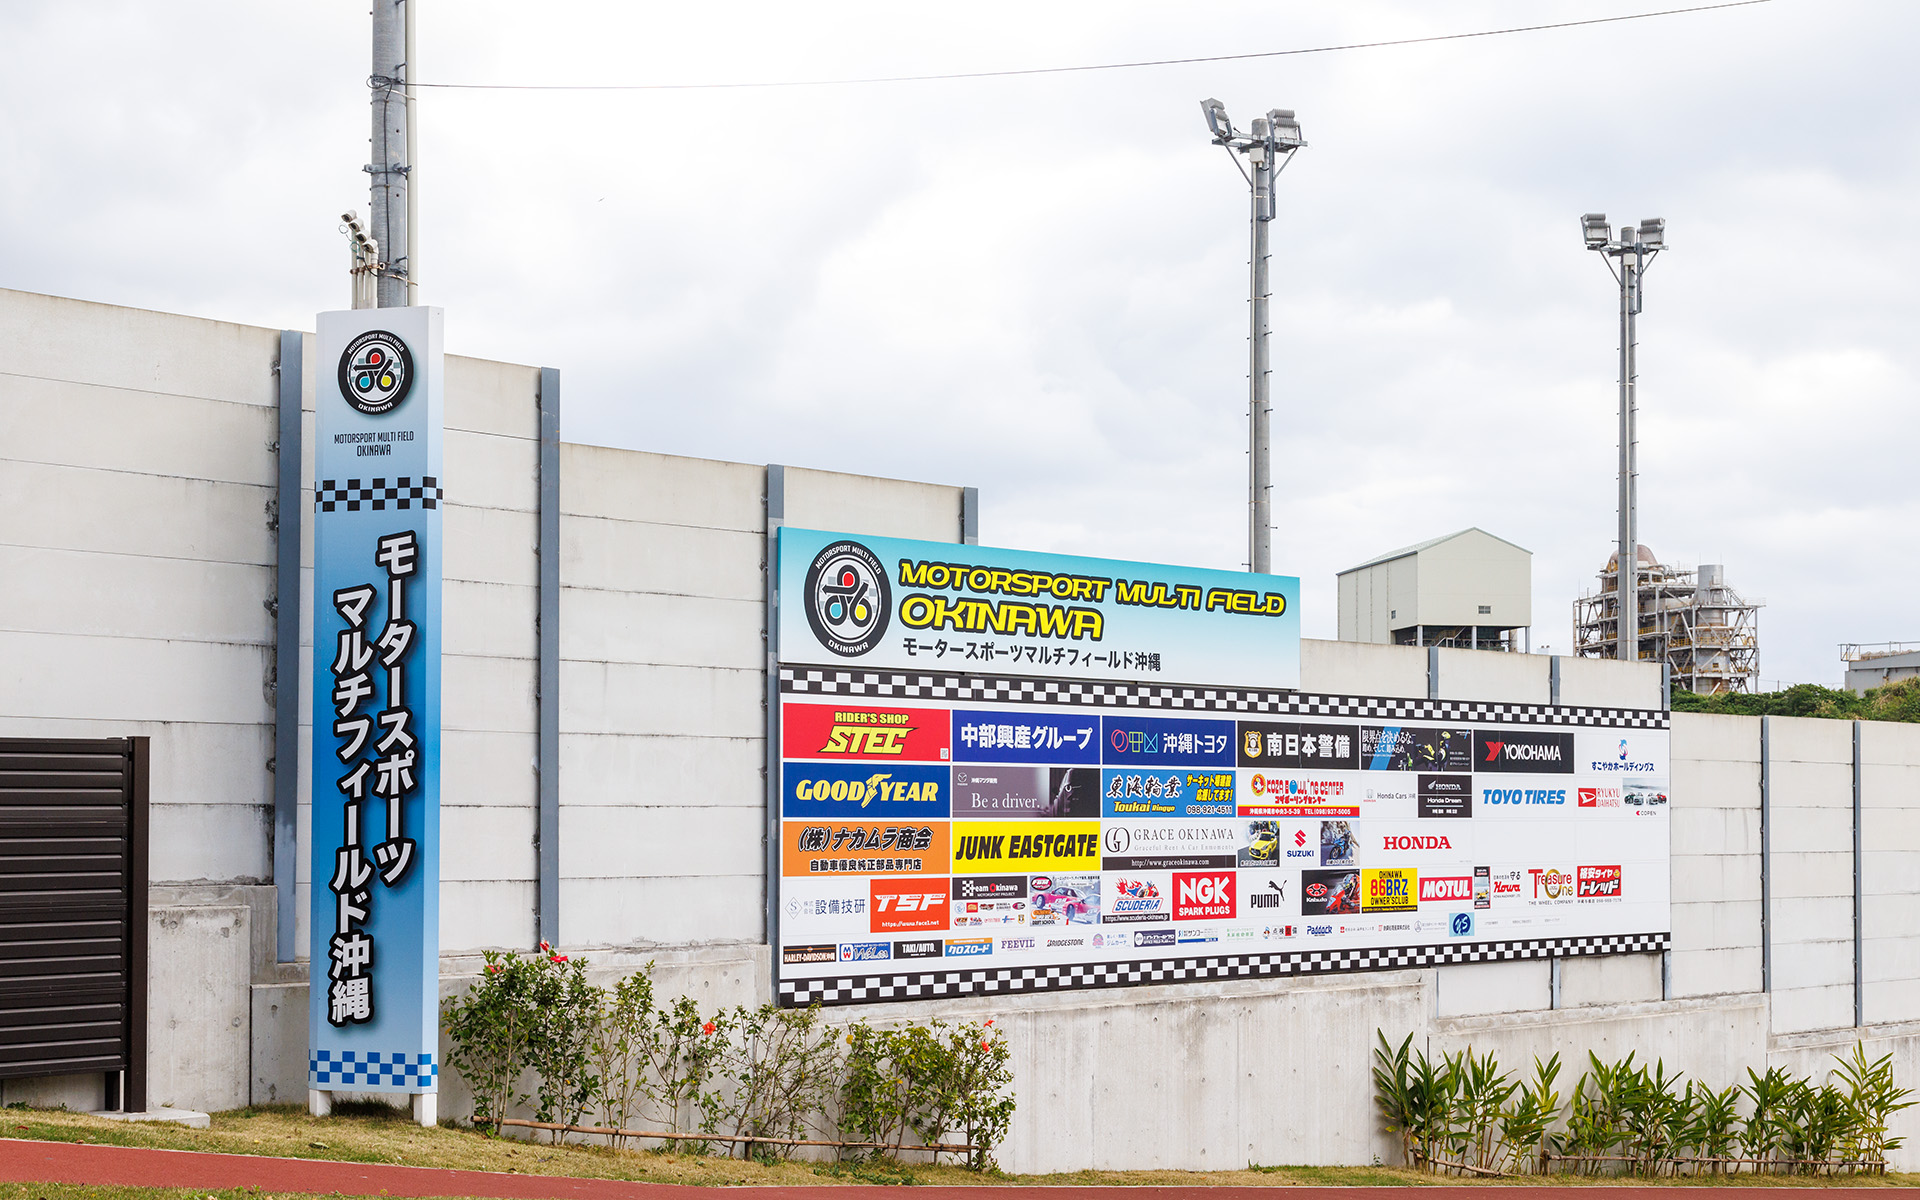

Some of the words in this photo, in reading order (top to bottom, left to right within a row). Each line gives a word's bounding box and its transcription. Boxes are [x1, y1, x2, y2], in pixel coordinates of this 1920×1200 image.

[347, 333, 378, 354] MOTORSPORT
[379, 334, 393, 344] MULTI
[393, 339, 405, 352] FIELD
[358, 402, 393, 412] OKINAWA
[334, 432, 376, 444] MOTORSPORT
[377, 431, 396, 443] MULTI
[397, 430, 414, 441] FIELD
[356, 445, 391, 457] OKINAWA
[815, 545, 851, 569] MOTORSPORT
[852, 545, 869, 558] MULTI
[868, 557, 882, 575] FIELD
[900, 561, 1111, 600] MOTORSPORT
[1116, 582, 1201, 608] MULTI
[1207, 590, 1286, 615] FIELD
[900, 596, 1103, 639] OKINAWA
[828, 639, 869, 653] OKINAWA
[903, 637, 1161, 672] モータースポーツマルチフィールド沖縄
[376, 534, 416, 883] モータースポーツ
[834, 712, 878, 724] RIDER'S
[879, 713, 909, 724] SHOP
[817, 725, 919, 755] STEC
[961, 723, 1093, 750] 中部興産グループ
[1163, 732, 1227, 754] 沖縄トヨタ
[1267, 732, 1350, 758] 南日本警備
[1504, 744, 1561, 761] YOKOHAMA
[1591, 761, 1654, 772] すこやかホールディングス
[1320, 781, 1344, 795] CENTER
[1435, 783, 1461, 791] HONDA
[1597, 788, 1620, 798] RYUKYU
[972, 792, 988, 808] Be
[992, 797, 999, 808] a
[1002, 793, 1040, 808] driver.
[1483, 789, 1524, 805] TOYO
[1525, 789, 1566, 805] TIRES
[332, 588, 374, 1023] マルチフィールド沖縄
[1114, 800, 1151, 812] Toukai
[1134, 828, 1174, 840] GRACE
[1178, 828, 1234, 840] OKINAWA
[955, 836, 1005, 860] JUNK
[1008, 834, 1098, 858] EASTGATE
[1383, 836, 1452, 850] HONDA
[810, 859, 922, 872] 自動車優良純正部品専門店
[1379, 870, 1402, 879] OKINAWA
[989, 883, 1018, 893] Okinawa
[1180, 876, 1230, 905] NGK
[1422, 880, 1470, 898] MOTUL
[1494, 881, 1521, 893] Howa
[1528, 869, 1572, 898] Treasure
[1579, 878, 1620, 895] トレッド
[815, 898, 865, 915] 設備技研
[874, 893, 946, 912] TSF
[1115, 898, 1160, 911] SCUDERIA
[1251, 894, 1279, 908] PUMA
[1179, 907, 1204, 916] SPARK
[1205, 905, 1230, 915] PLUGS
[948, 944, 990, 954] クロスロード
[1001, 939, 1035, 949] FEEVIL
[1046, 939, 1084, 947] BRIDGESTONE
